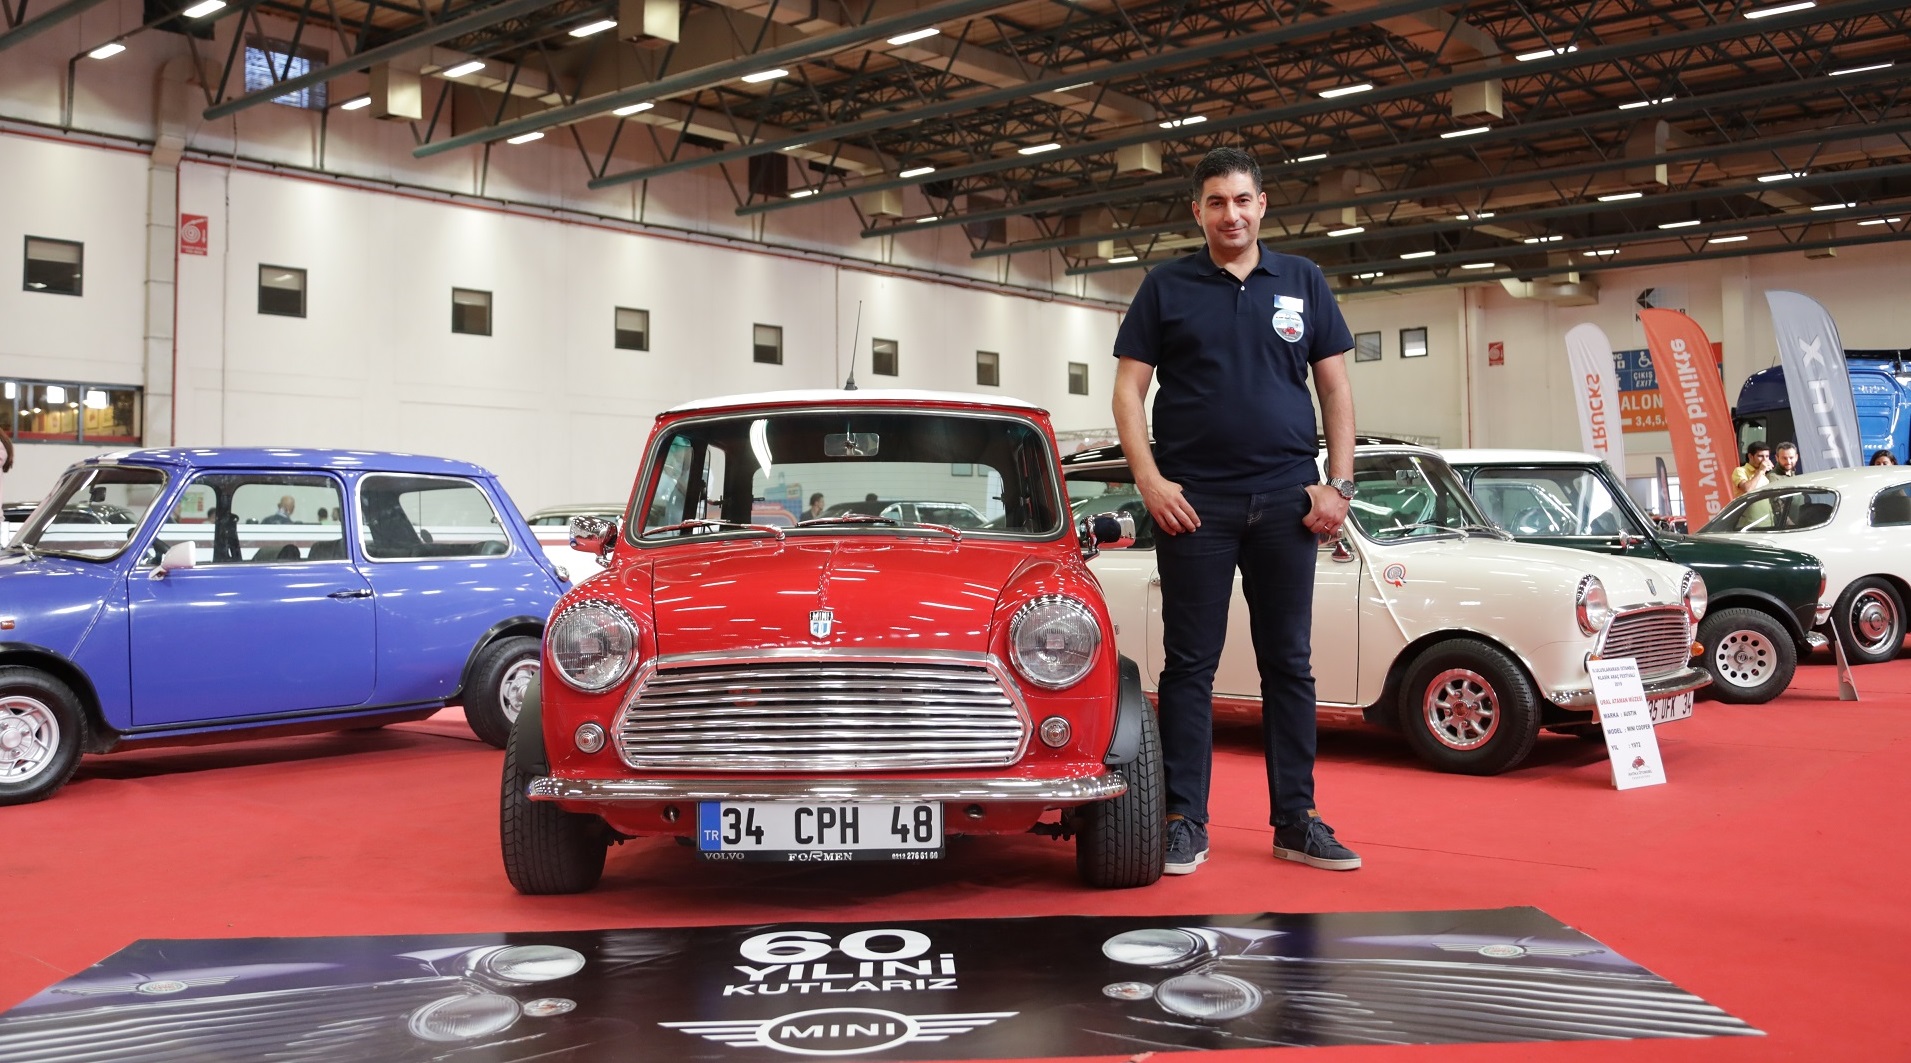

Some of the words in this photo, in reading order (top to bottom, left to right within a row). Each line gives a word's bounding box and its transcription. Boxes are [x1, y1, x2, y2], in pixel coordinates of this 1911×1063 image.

[1621, 393, 1663, 411] ALON
[1635, 414, 1667, 427] 3,4,5,
[1683, 692, 1691, 715] 34
[723, 808, 764, 845] 34
[795, 807, 860, 844] CPH
[891, 806, 933, 843] 48
[704, 830, 719, 841] TR
[704, 852, 745, 860] VOLVO
[788, 851, 852, 861] FORMEN
[740, 929, 931, 964] 60
[722, 978, 958, 996] KUTLARIZ
[780, 1022, 896, 1039] MINI
